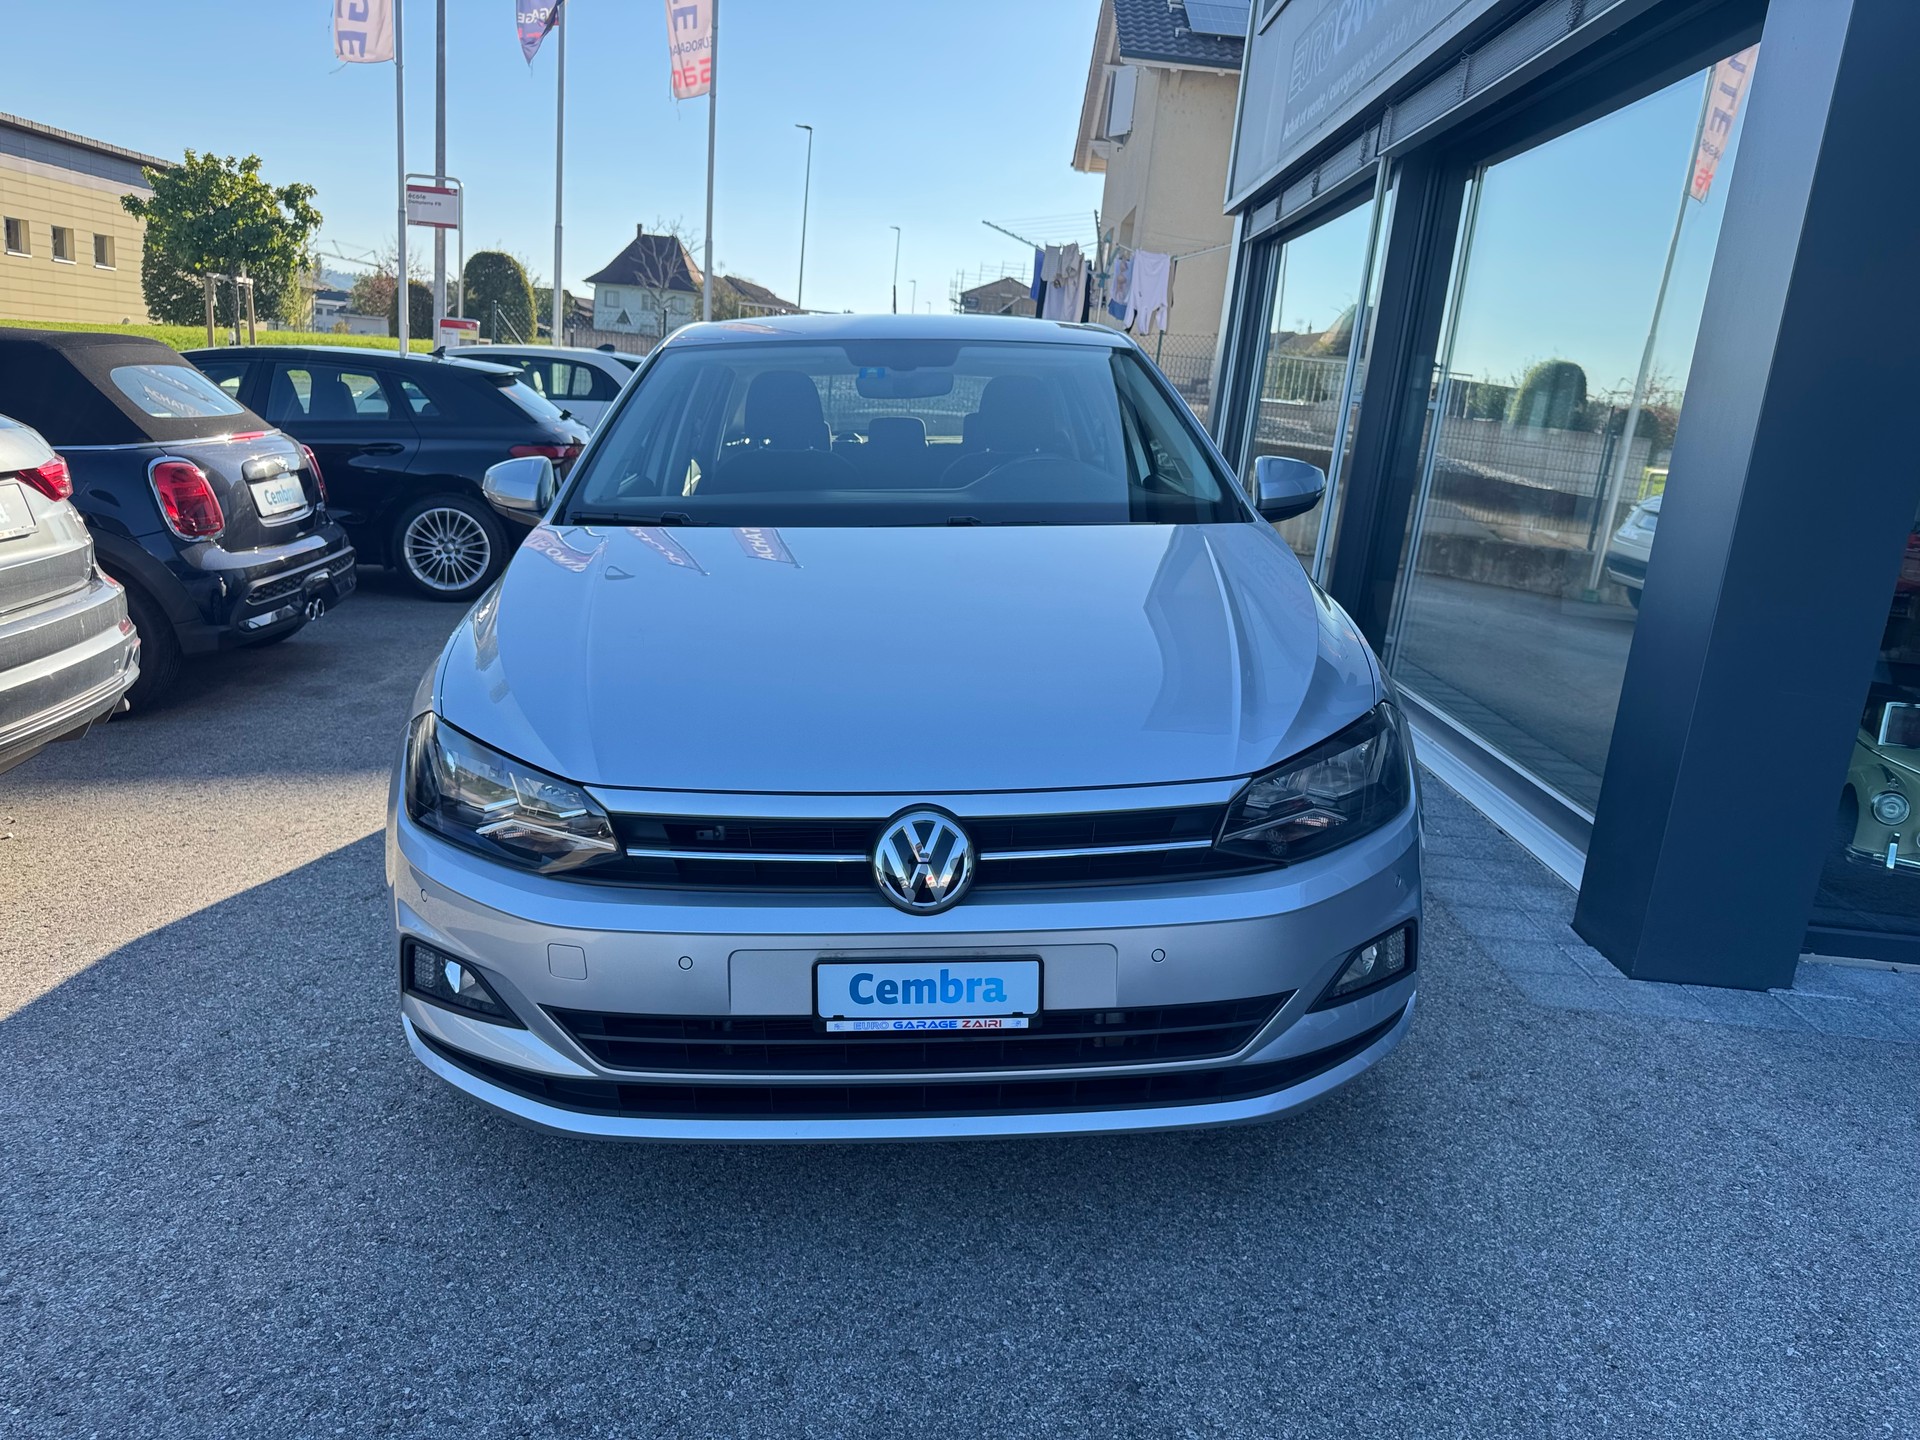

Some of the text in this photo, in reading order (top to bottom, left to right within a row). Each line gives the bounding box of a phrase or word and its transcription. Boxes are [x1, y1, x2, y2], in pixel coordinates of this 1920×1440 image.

[849, 968, 1008, 1005] Cembra
[853, 1019, 1003, 1031] EURO GARAGE ZAIRI
